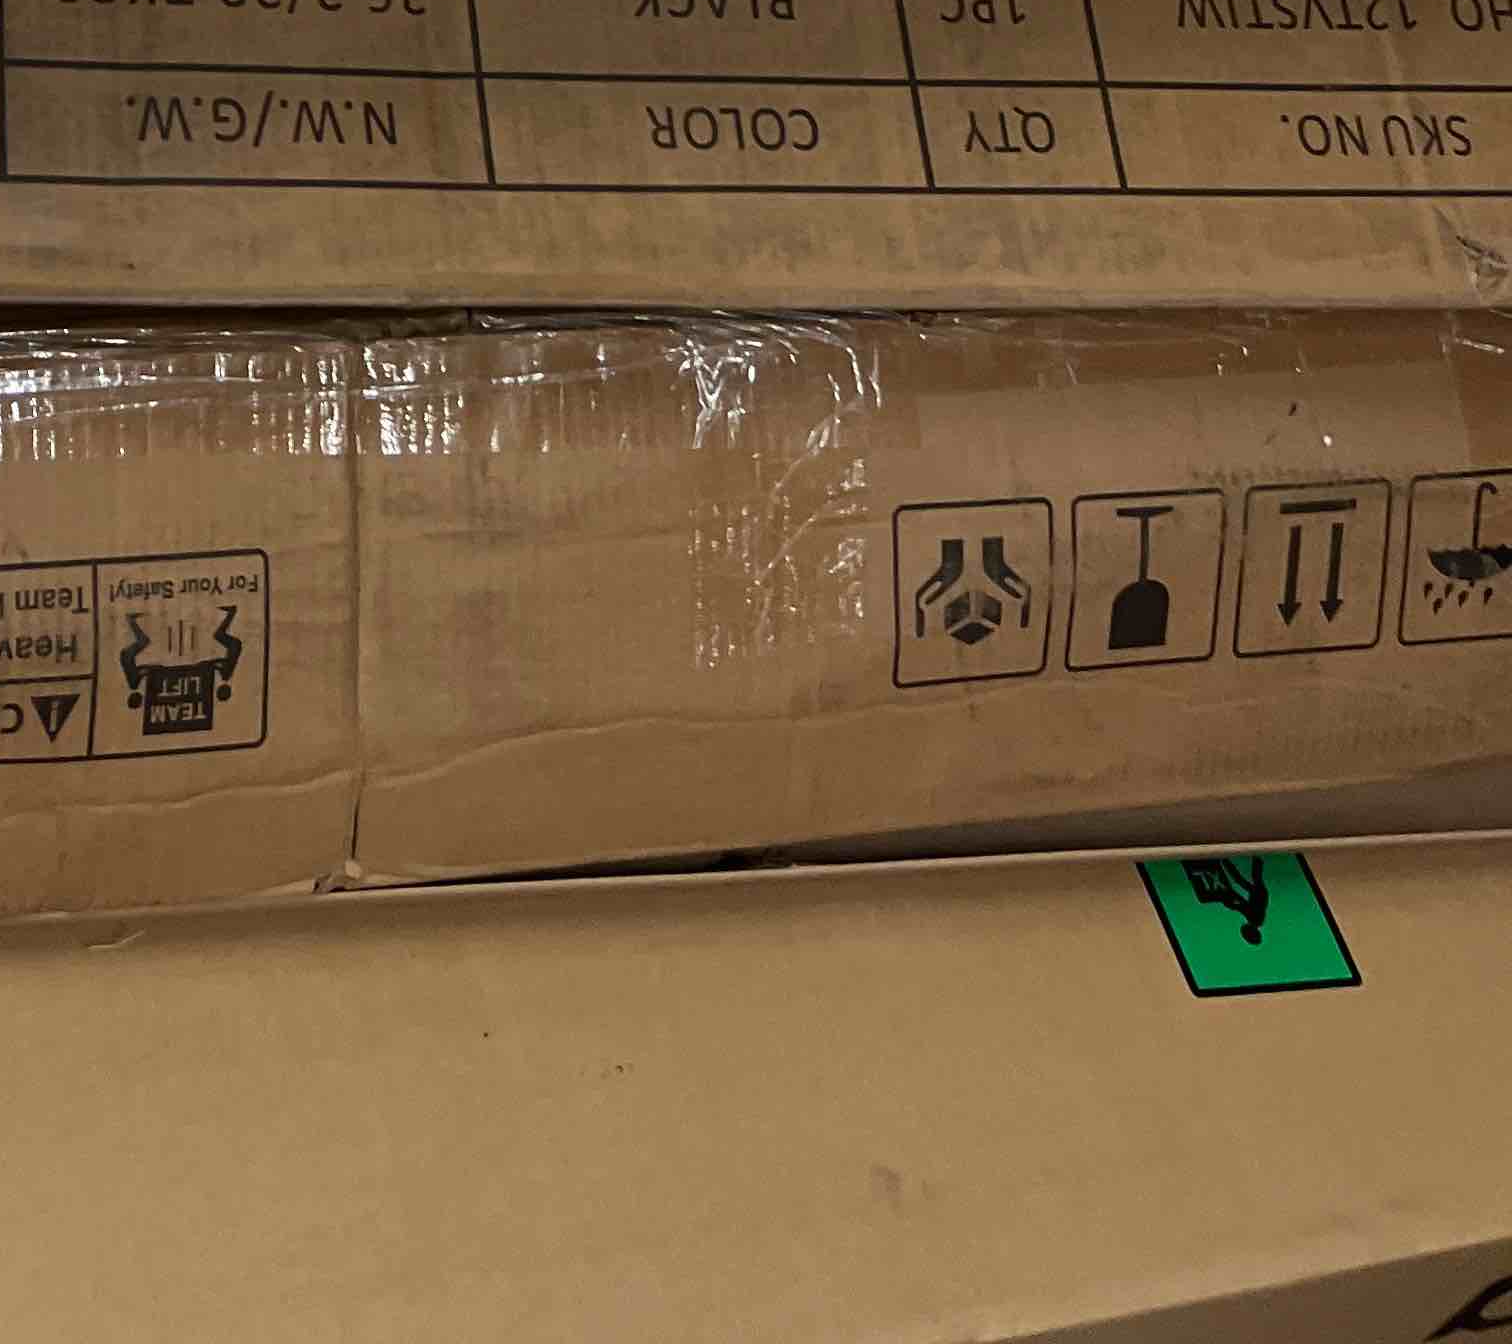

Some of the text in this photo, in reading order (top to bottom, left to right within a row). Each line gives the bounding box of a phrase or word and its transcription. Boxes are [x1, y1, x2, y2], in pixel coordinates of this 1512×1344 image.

[125, 90, 399, 148] N.W./G.W.
[647, 105, 821, 153] COLOR
[964, 105, 1057, 155] QTY
[1279, 111, 1474, 158] SKU NO.
[15, 584, 90, 613] Team
[109, 573, 259, 604] For Your Safety!
[158, 676, 202, 698] LIFT
[150, 700, 208, 725] TEAM
